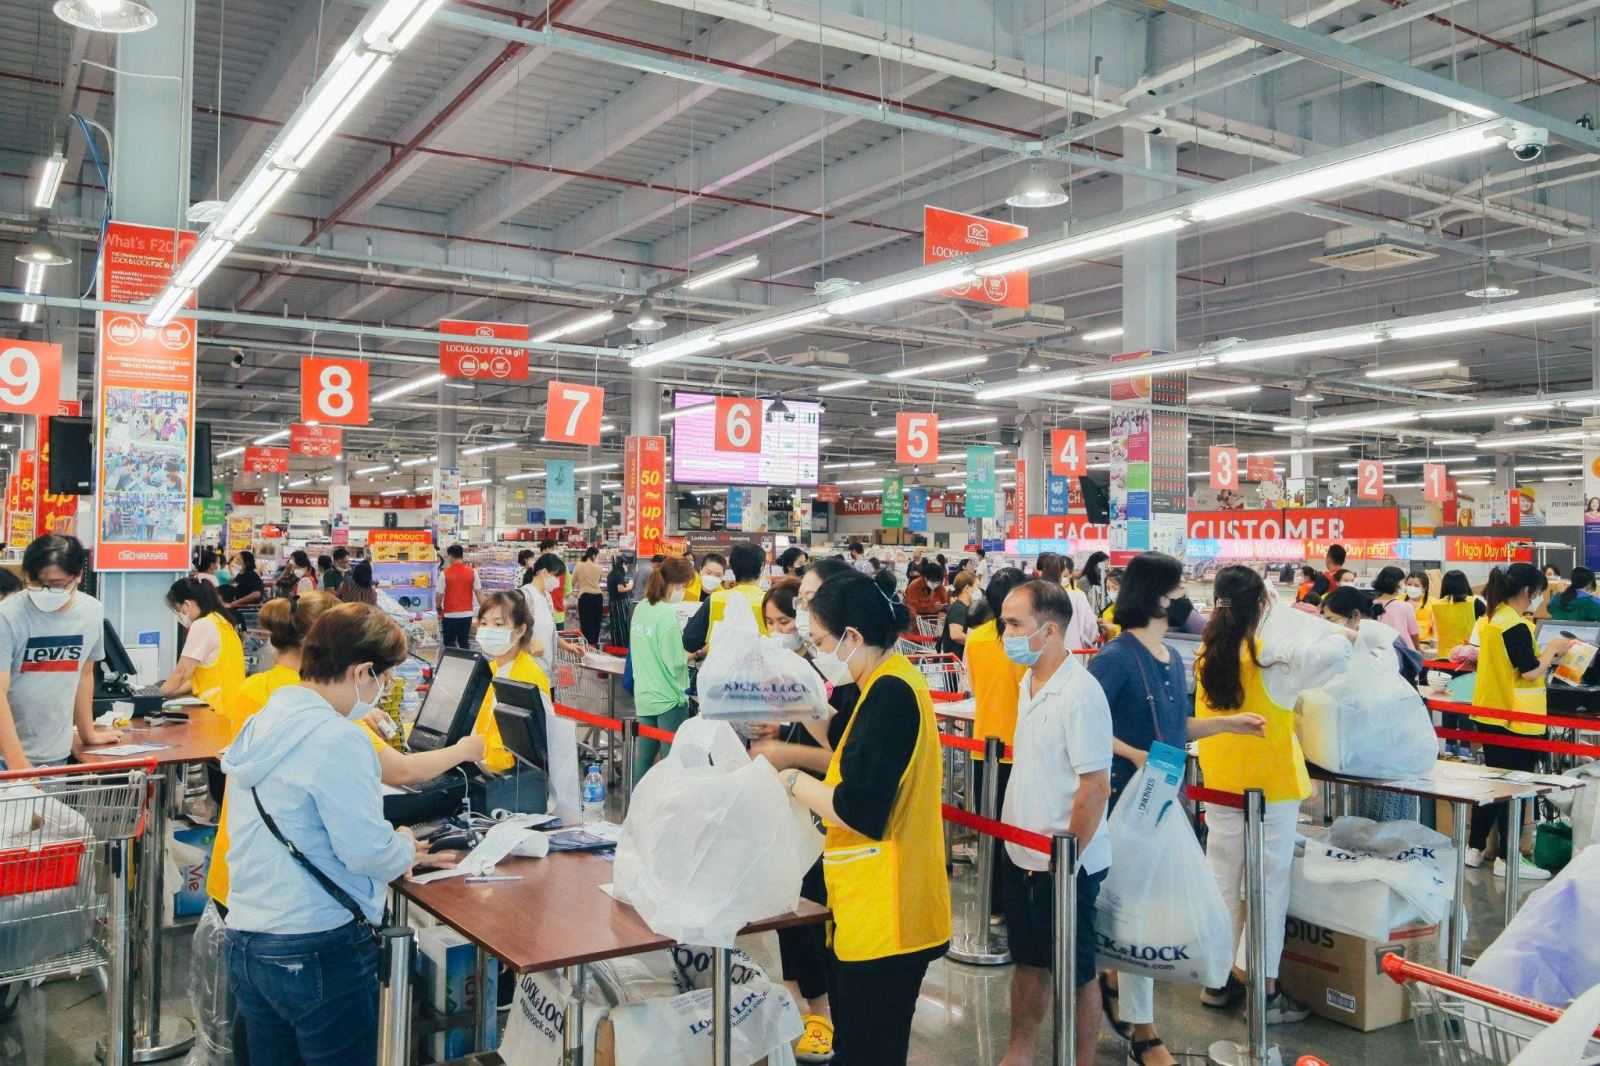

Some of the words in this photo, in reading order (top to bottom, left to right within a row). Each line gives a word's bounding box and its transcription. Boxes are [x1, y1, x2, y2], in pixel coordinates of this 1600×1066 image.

[106, 233, 145, 250] What's
[150, 239, 173, 252] F2C
[111, 256, 149, 266] LOCK&LOCK
[150, 260, 164, 268] F2C
[446, 344, 489, 354] LOCK&LOCK
[490, 348, 504, 356] F2C
[0, 347, 40, 406] 9
[318, 365, 353, 417] 8
[563, 389, 590, 437] 7
[726, 403, 752, 447] 6
[907, 418, 929, 458] 5
[1060, 434, 1079, 471] 4
[641, 470, 660, 485] 50
[1216, 451, 1232, 485] 3
[1364, 464, 1378, 496] 2
[1430, 468, 1439, 498] 1
[254, 497, 293, 505] FARY
[845, 502, 875, 511] FACTORY
[642, 505, 662, 520] up
[643, 524, 660, 539] to
[1054, 522, 1110, 539] FACT
[1191, 518, 1345, 540] CUSTOMER
[1307, 540, 1314, 556] 1
[1344, 543, 1364, 557] Duy
[1455, 538, 1460, 557] 1
